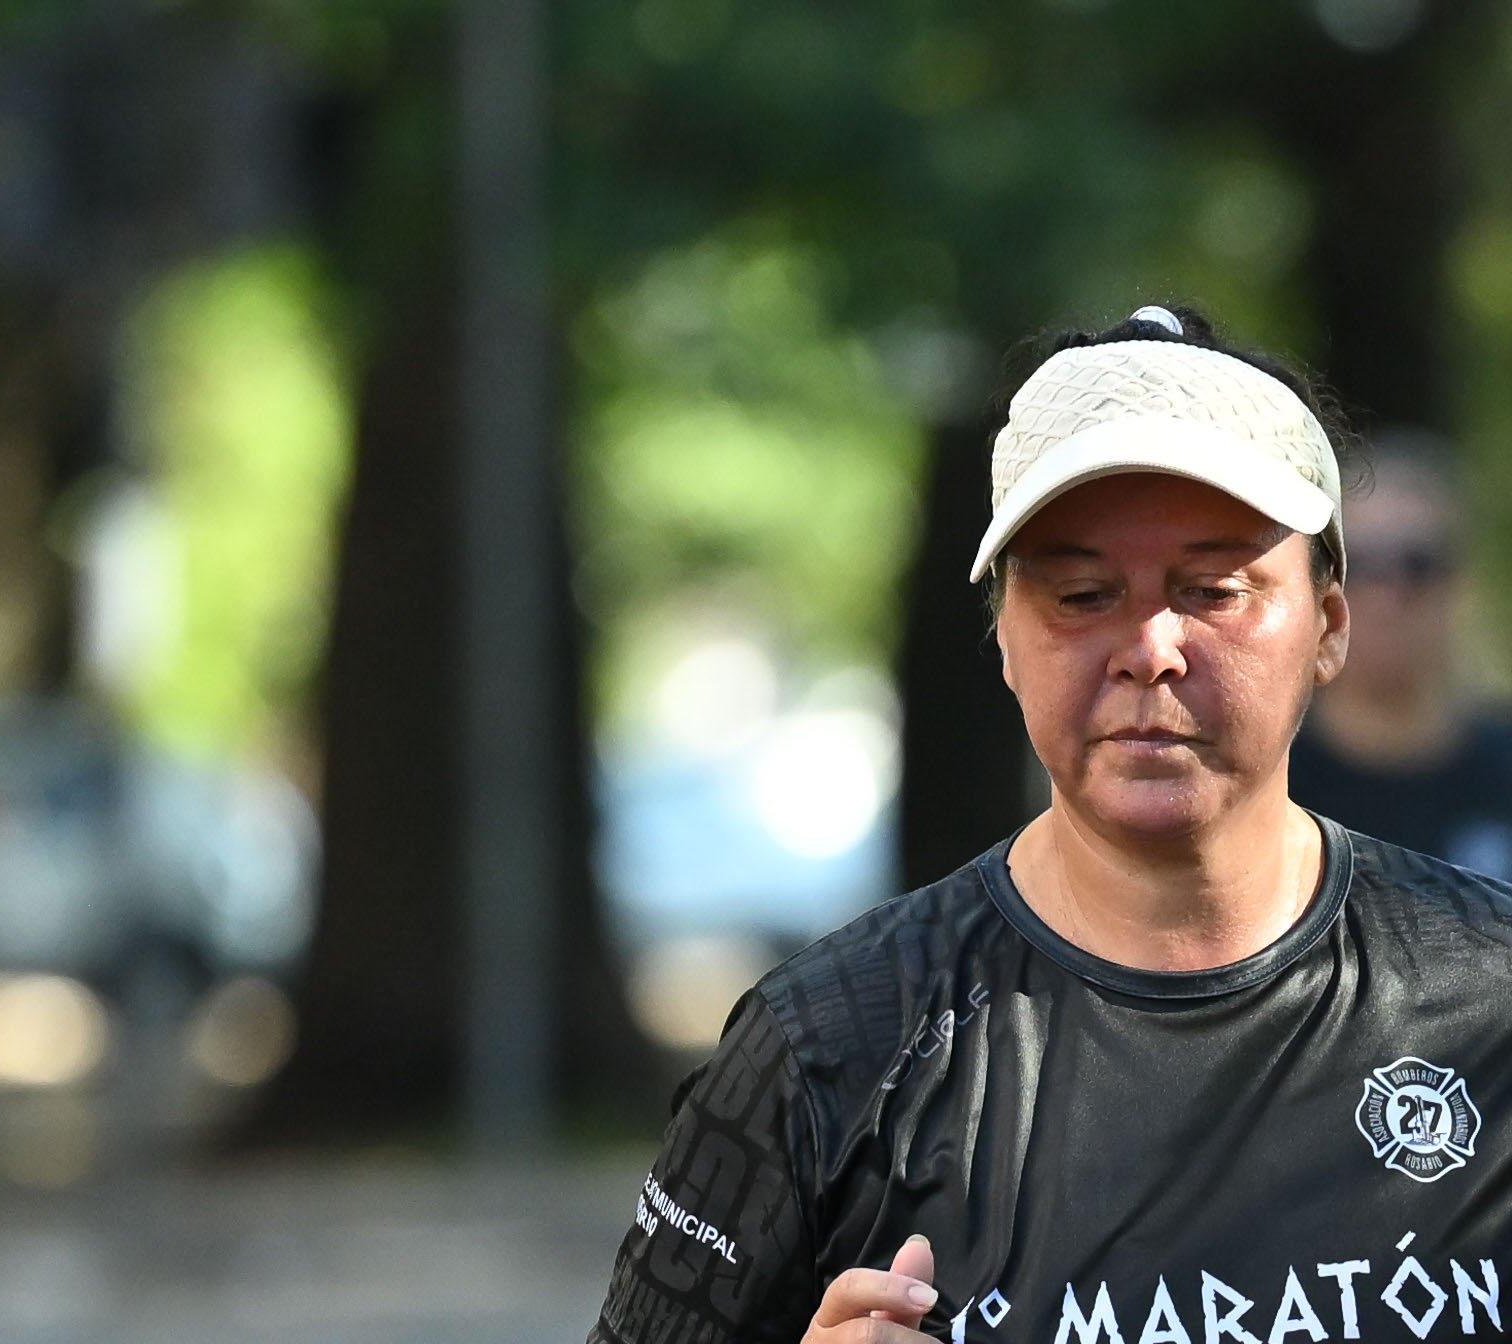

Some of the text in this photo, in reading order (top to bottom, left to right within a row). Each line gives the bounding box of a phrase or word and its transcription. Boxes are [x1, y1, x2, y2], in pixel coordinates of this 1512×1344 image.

[1390, 1068, 1439, 1086] BOMBEROS
[1396, 1094, 1443, 1135] 27
[1404, 1153, 1443, 1171] ROSARIO
[651, 1191, 737, 1265] MUNICIPAL
